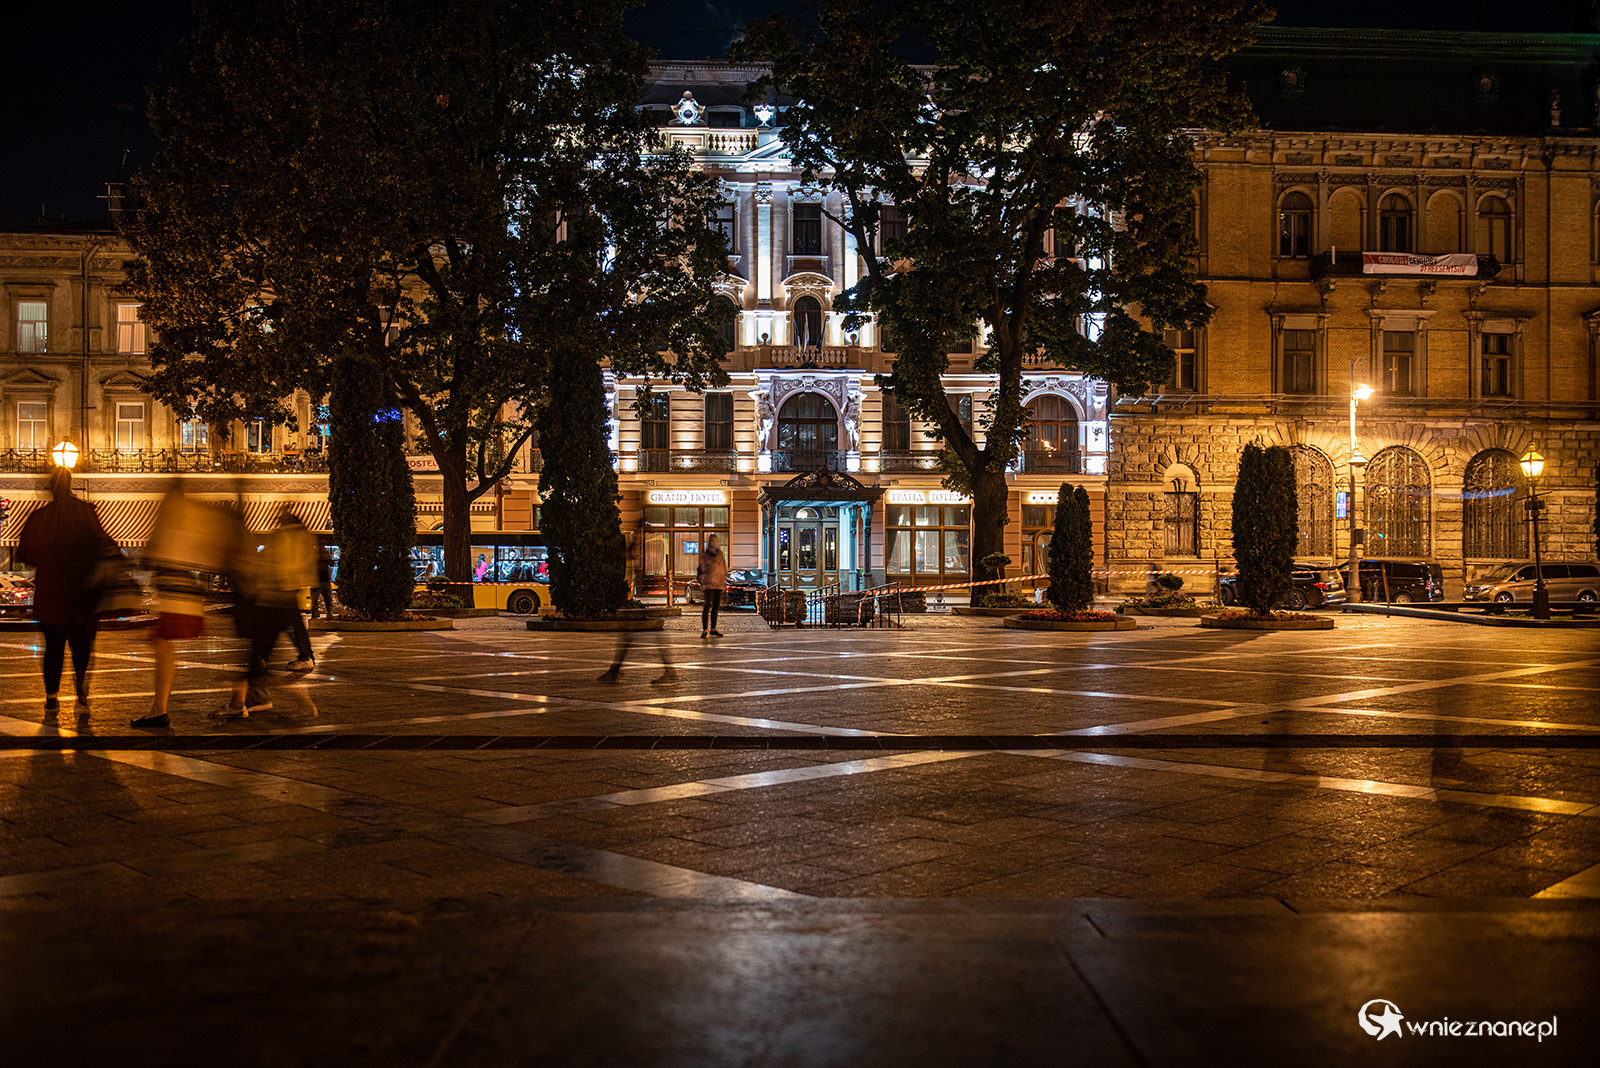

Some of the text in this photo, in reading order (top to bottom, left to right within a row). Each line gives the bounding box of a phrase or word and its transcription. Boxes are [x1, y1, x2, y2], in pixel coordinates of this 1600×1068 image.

[650, 493, 722, 502] GRAND HOTEL
[892, 493, 924, 502] ГРАНД
